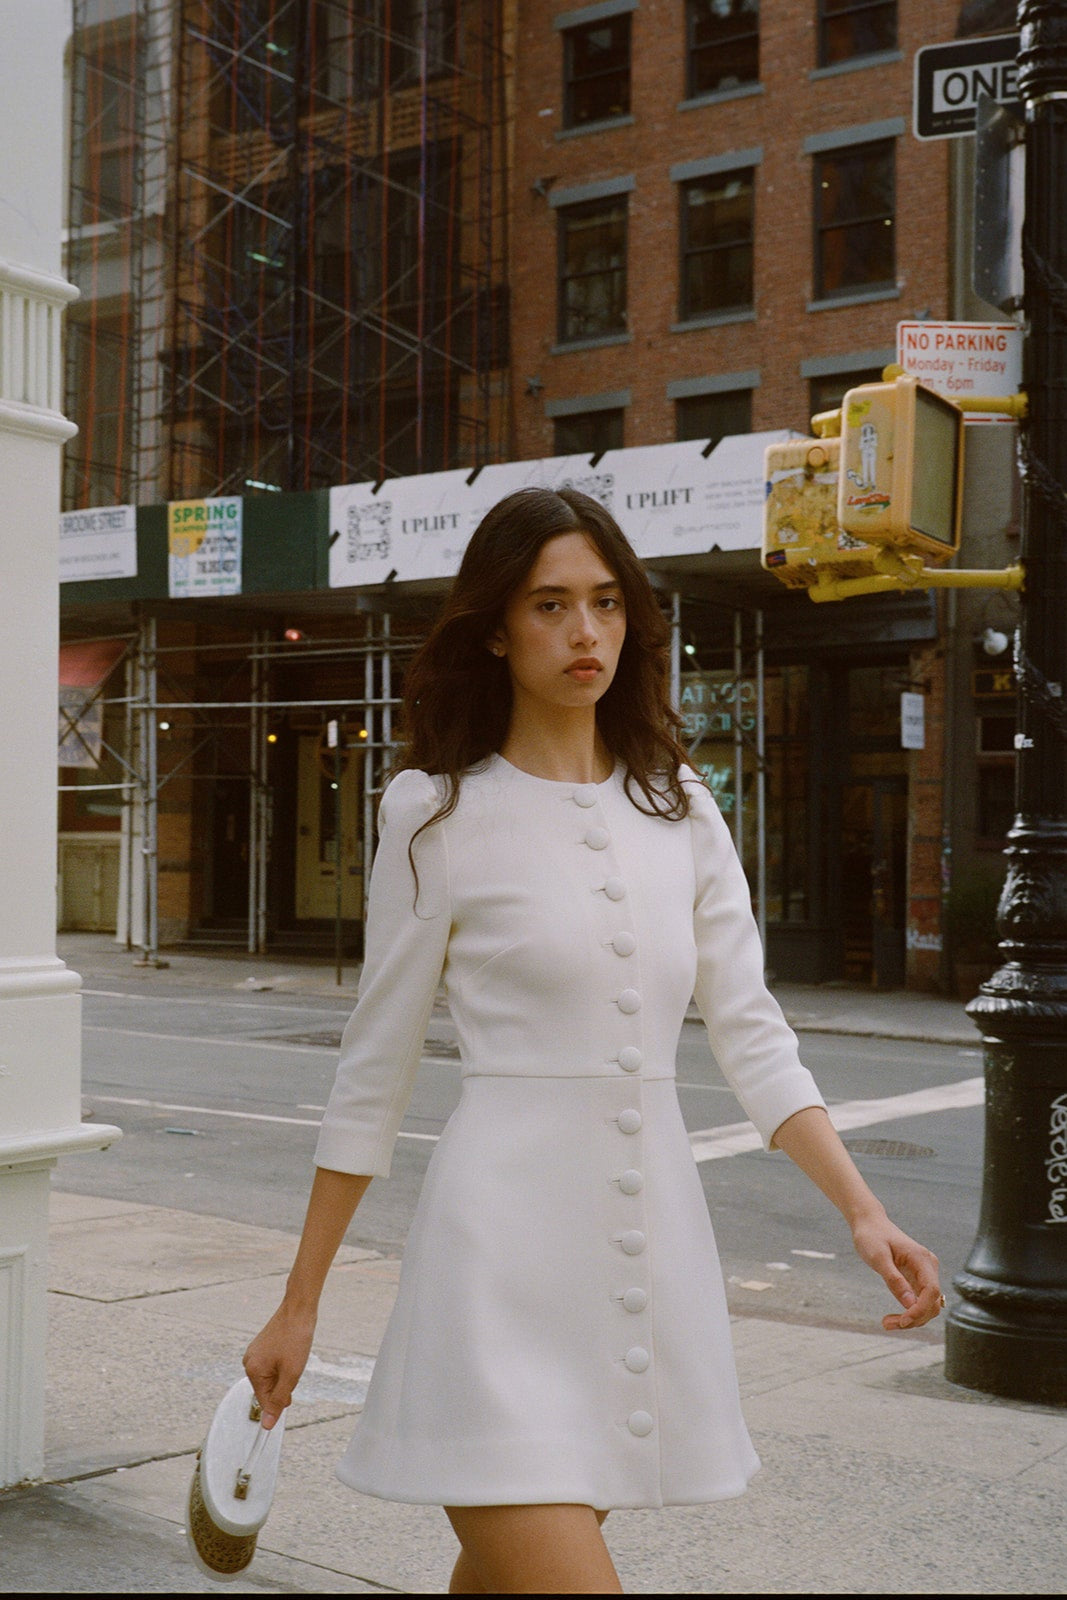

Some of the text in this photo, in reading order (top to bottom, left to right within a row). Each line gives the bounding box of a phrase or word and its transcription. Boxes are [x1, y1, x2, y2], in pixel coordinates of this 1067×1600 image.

[943, 66, 1017, 105] ONE
[907, 333, 1008, 352] NO PARKING
[907, 357, 954, 374] Monday
[968, 357, 1006, 374] Friday
[946, 376, 975, 392] 6pm
[626, 486, 694, 510] UPLIFT
[173, 503, 238, 524] SPRING
[402, 513, 461, 535] UPLIFT
[681, 681, 756, 705] ATTOO
